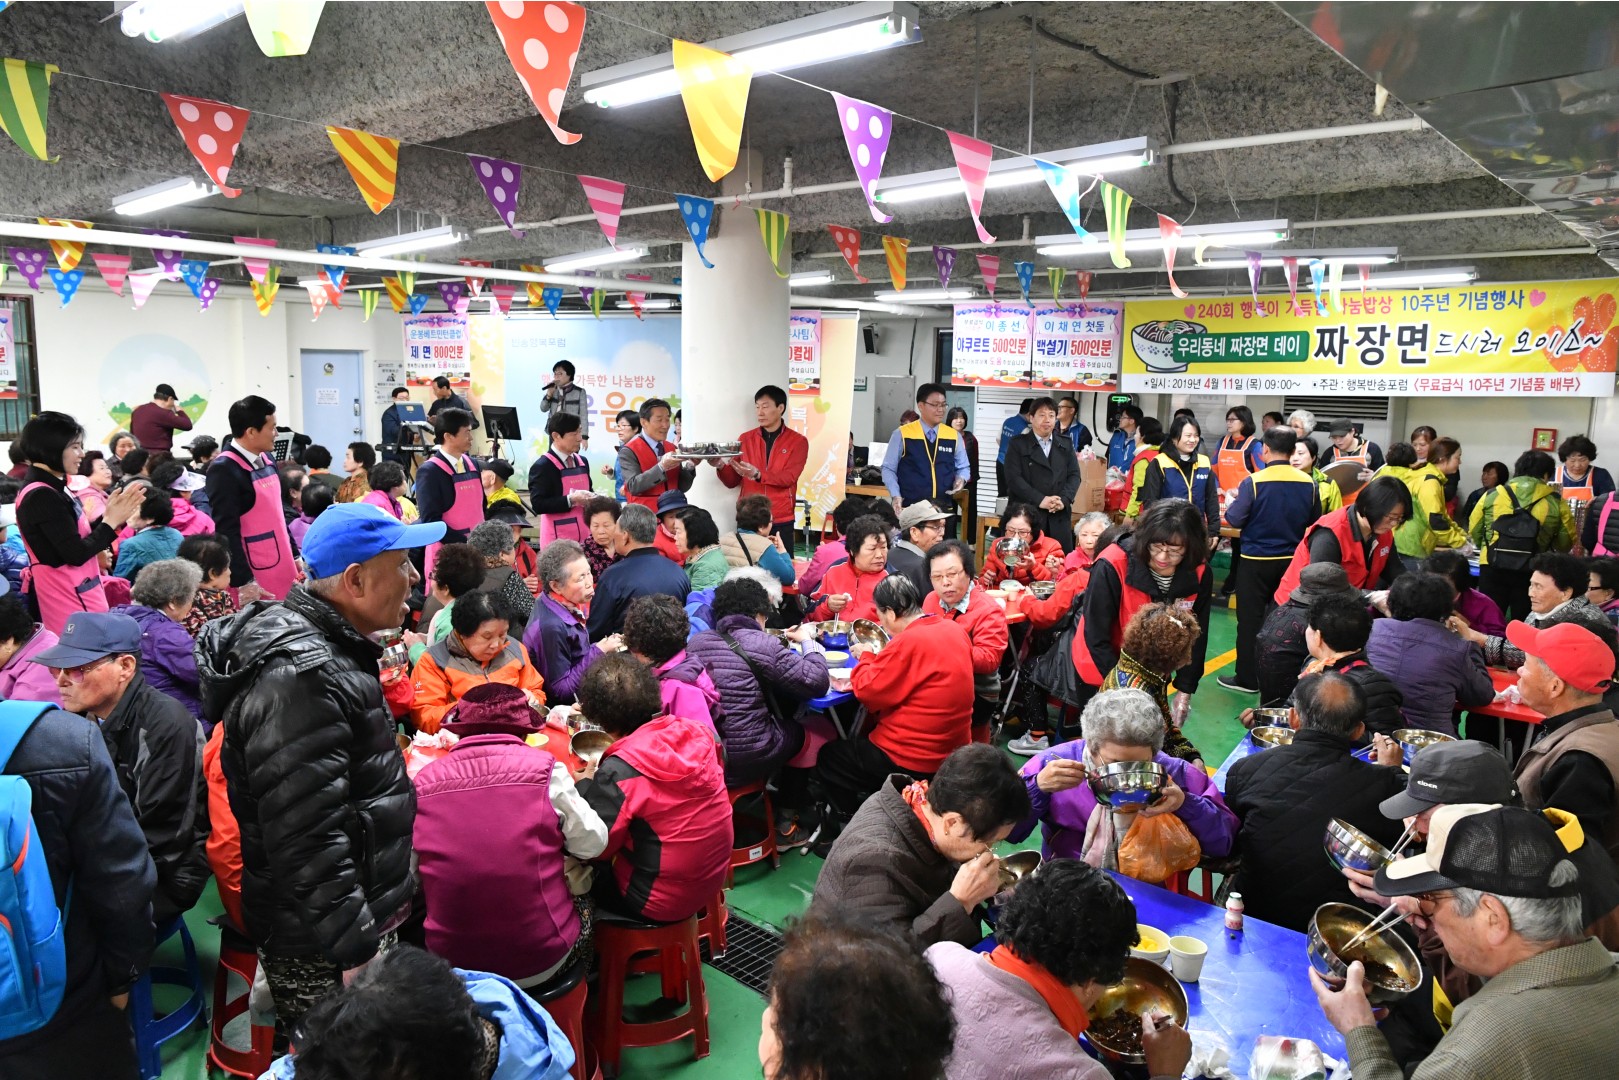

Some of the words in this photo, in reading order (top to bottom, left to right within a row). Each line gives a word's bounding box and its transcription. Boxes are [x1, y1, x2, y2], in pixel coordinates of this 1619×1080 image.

[1198, 301, 1234, 318] 240회
[1342, 296, 1393, 315] 눔밥상
[1401, 293, 1450, 312] 10주년
[1458, 289, 1525, 311] 기념행사
[789, 327, 810, 341] 사팀
[957, 337, 990, 353] 야쿠르트
[992, 338, 1027, 354] 500인분
[1036, 339, 1068, 356] 백설기
[1070, 339, 1112, 356] 500인분
[1177, 335, 1225, 358] 우리동네
[1230, 335, 1268, 357] 짜장면
[1274, 335, 1300, 357] 데이
[1314, 323, 1428, 365] 짜장면
[1435, 331, 1502, 353] 드시러
[434, 345, 463, 359] 800인분
[577, 374, 608, 387] 가득한
[612, 375, 656, 389] 나눔밥상
[1172, 378, 1201, 389] 2019년
[1204, 378, 1219, 390] 4월
[1222, 378, 1243, 390] 11일
[1246, 378, 1262, 390] (목)
[1346, 378, 1408, 392] 행복반송포럼
[1468, 377, 1505, 391] 10주년
[1510, 377, 1546, 392] 기념품
